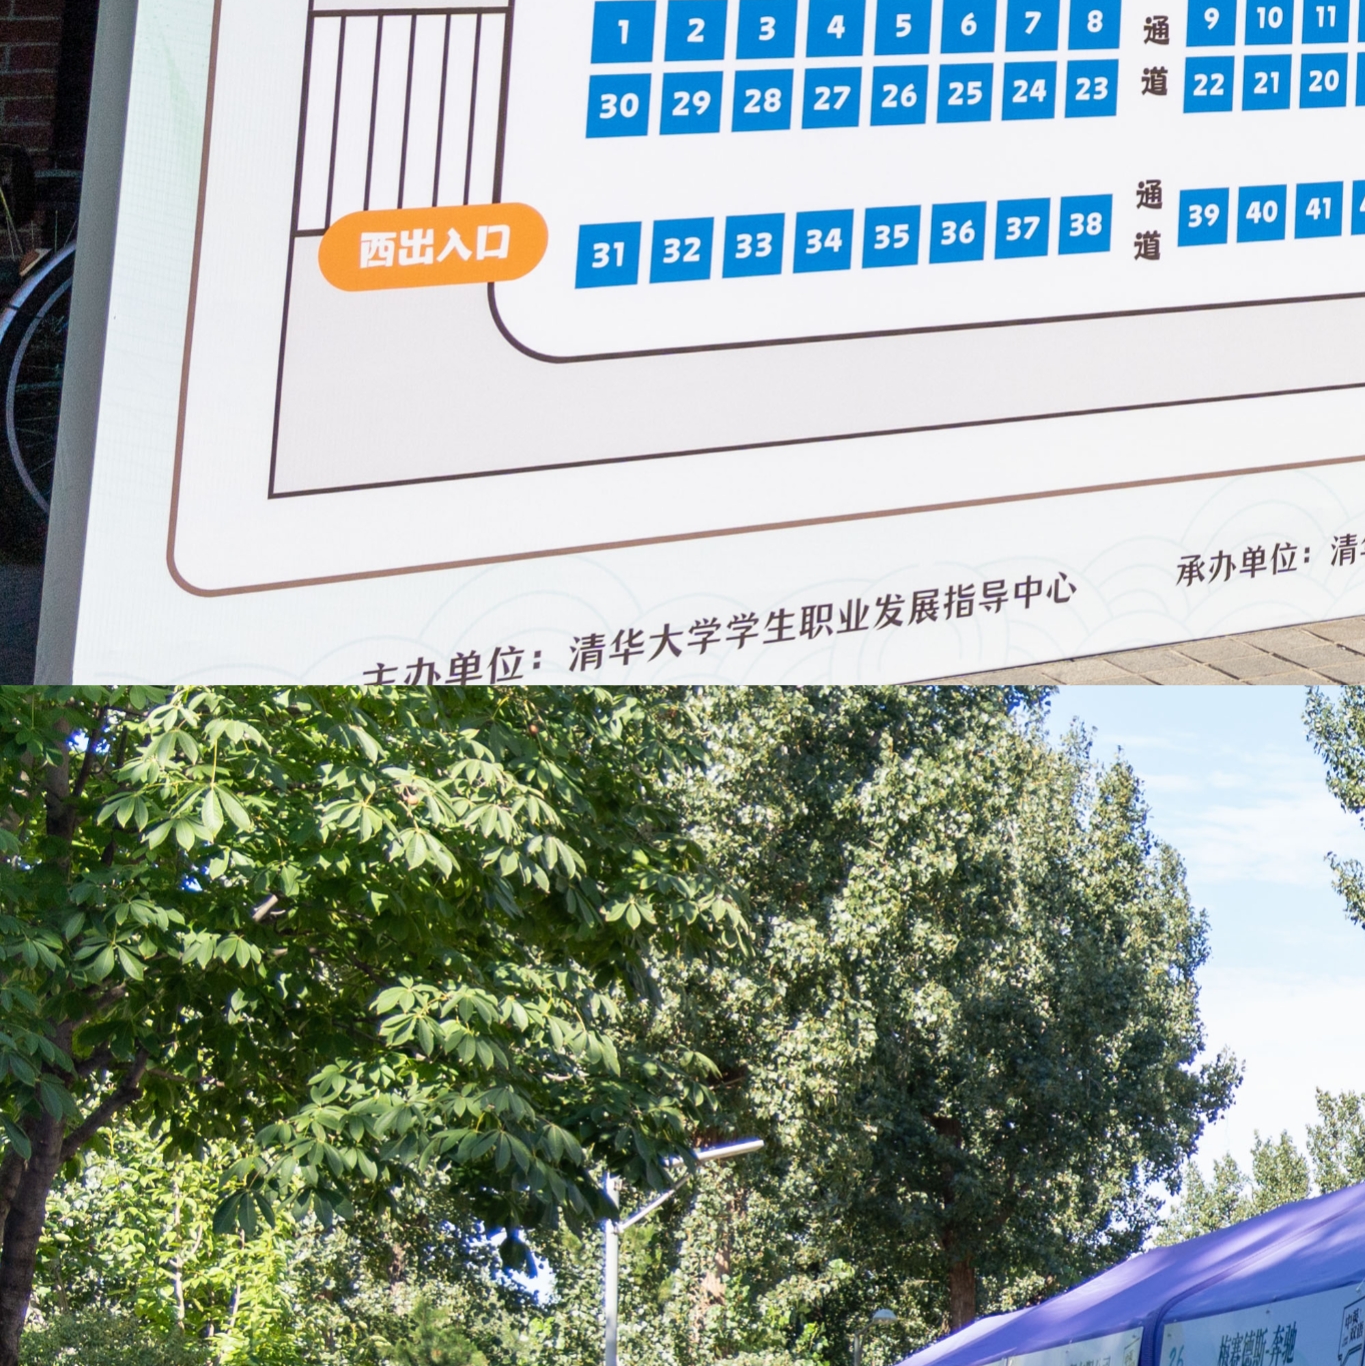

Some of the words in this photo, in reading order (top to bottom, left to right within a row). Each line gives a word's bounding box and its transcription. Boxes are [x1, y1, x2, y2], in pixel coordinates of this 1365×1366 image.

[617, 19, 630, 45] 1
[686, 17, 705, 43] 2
[758, 16, 776, 41] 3
[826, 14, 846, 39] 4
[895, 13, 912, 38] 5
[960, 12, 977, 36] 6
[1024, 10, 1042, 35] 7
[1086, 9, 1104, 33] 8
[1203, 7, 1220, 30] 9
[1256, 6, 1284, 29] 10
[1315, 5, 1337, 28] 11
[359, 225, 512, 270] 西出入口
